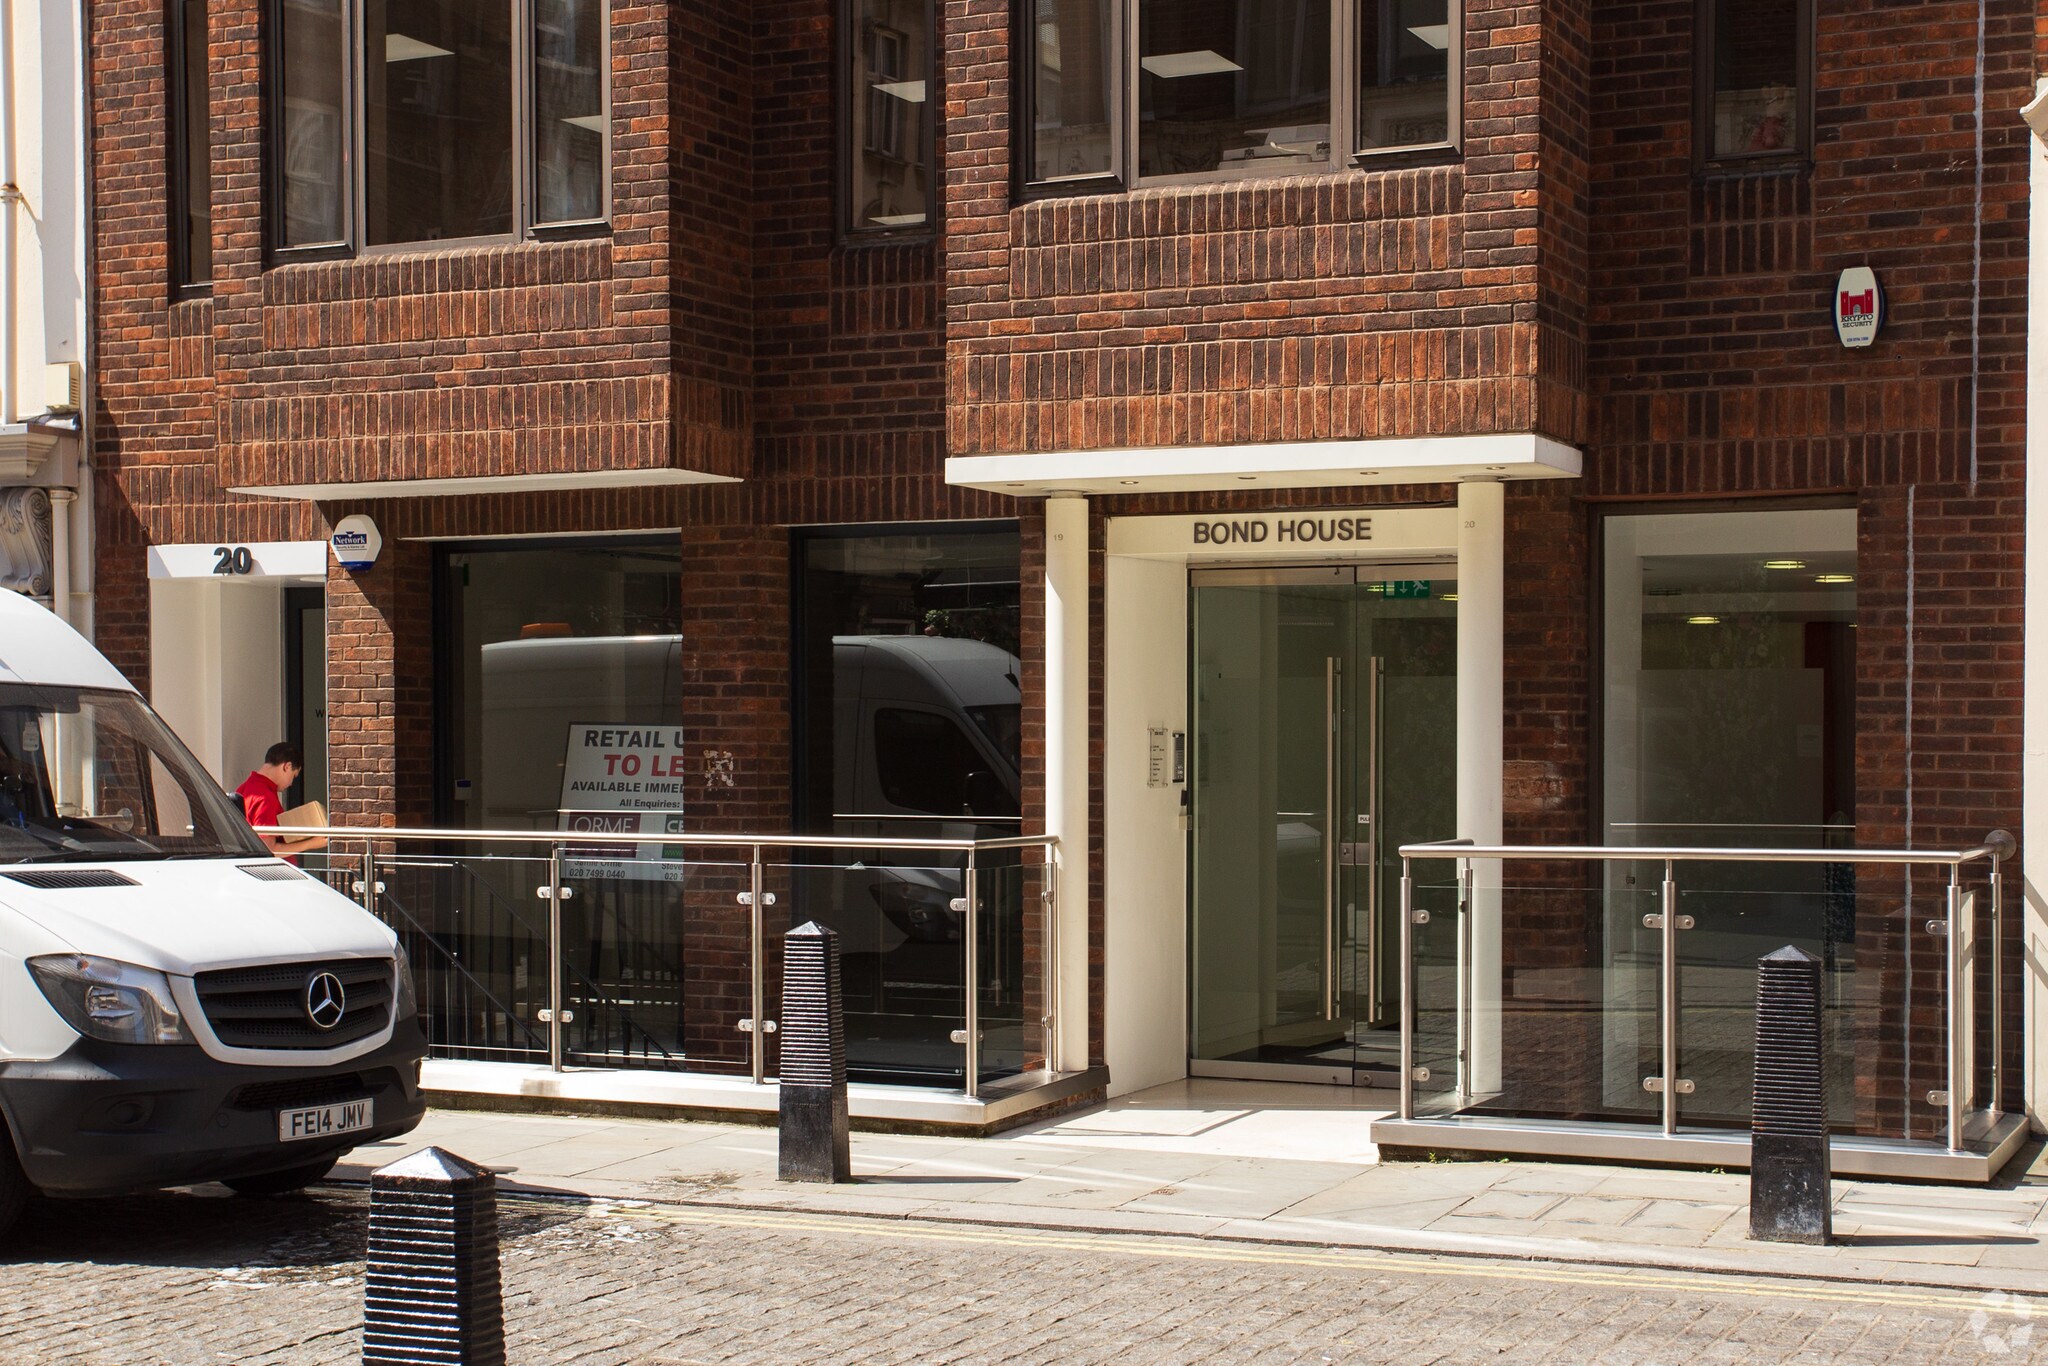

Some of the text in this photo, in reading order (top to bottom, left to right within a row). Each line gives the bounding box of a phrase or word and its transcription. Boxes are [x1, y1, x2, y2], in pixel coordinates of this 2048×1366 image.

[1841, 314, 1873, 323] KRYPTO
[1842, 320, 1873, 328] SECURITY
[1193, 517, 1372, 545] BOND HOUSE
[335, 535, 366, 545] Network
[1053, 533, 1064, 541] 19
[213, 546, 252, 575] 20
[584, 730, 665, 748] RETAIL
[604, 754, 684, 776] TO LE
[571, 781, 641, 793] AVAILABLE
[619, 798, 680, 809] All Enquiries:
[569, 868, 625, 879] 020 7499 0440
[291, 1103, 365, 1136] FE14 JMV
